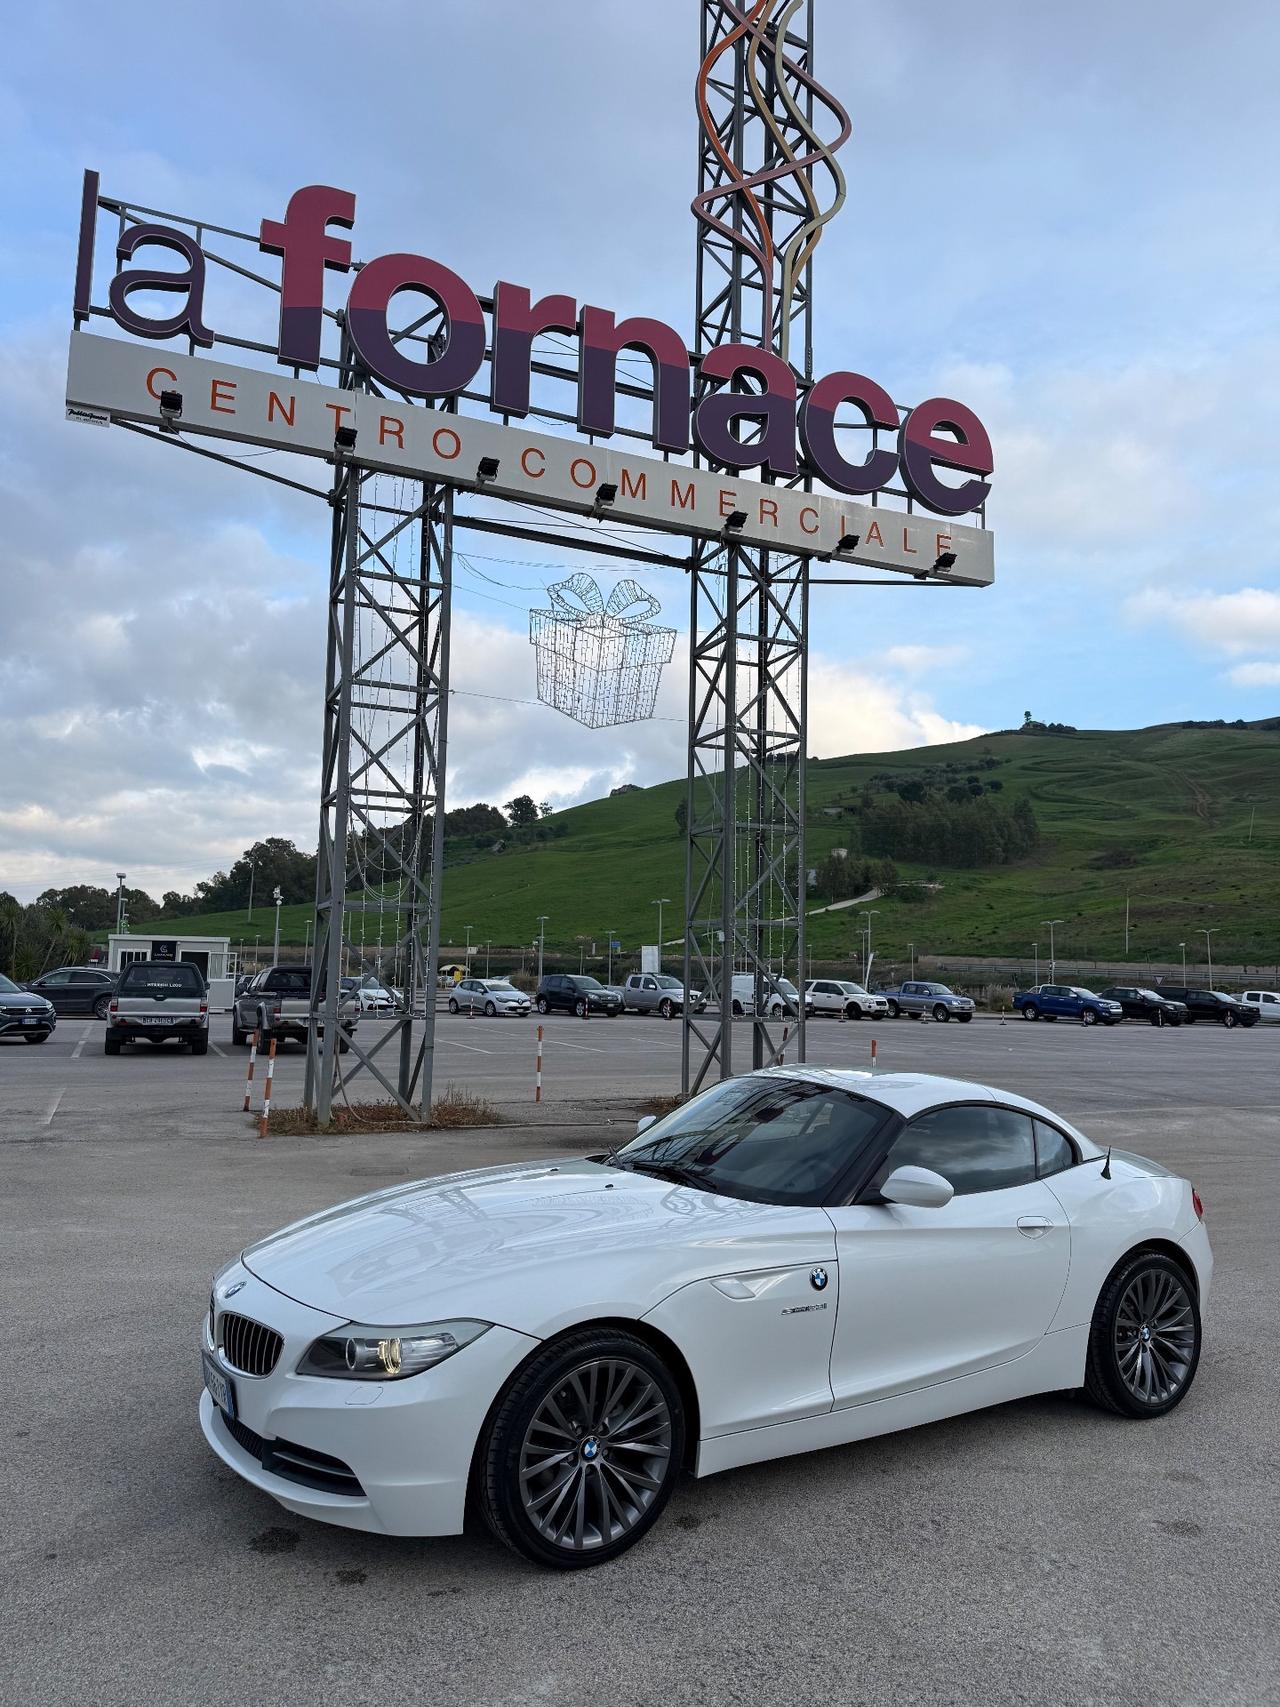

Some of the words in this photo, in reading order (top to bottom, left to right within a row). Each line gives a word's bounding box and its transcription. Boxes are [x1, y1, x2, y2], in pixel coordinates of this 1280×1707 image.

[73, 168, 215, 349] la
[260, 184, 995, 517] fornace
[146, 367, 462, 460] CENTRO
[521, 447, 952, 558] COMMERCIALE
